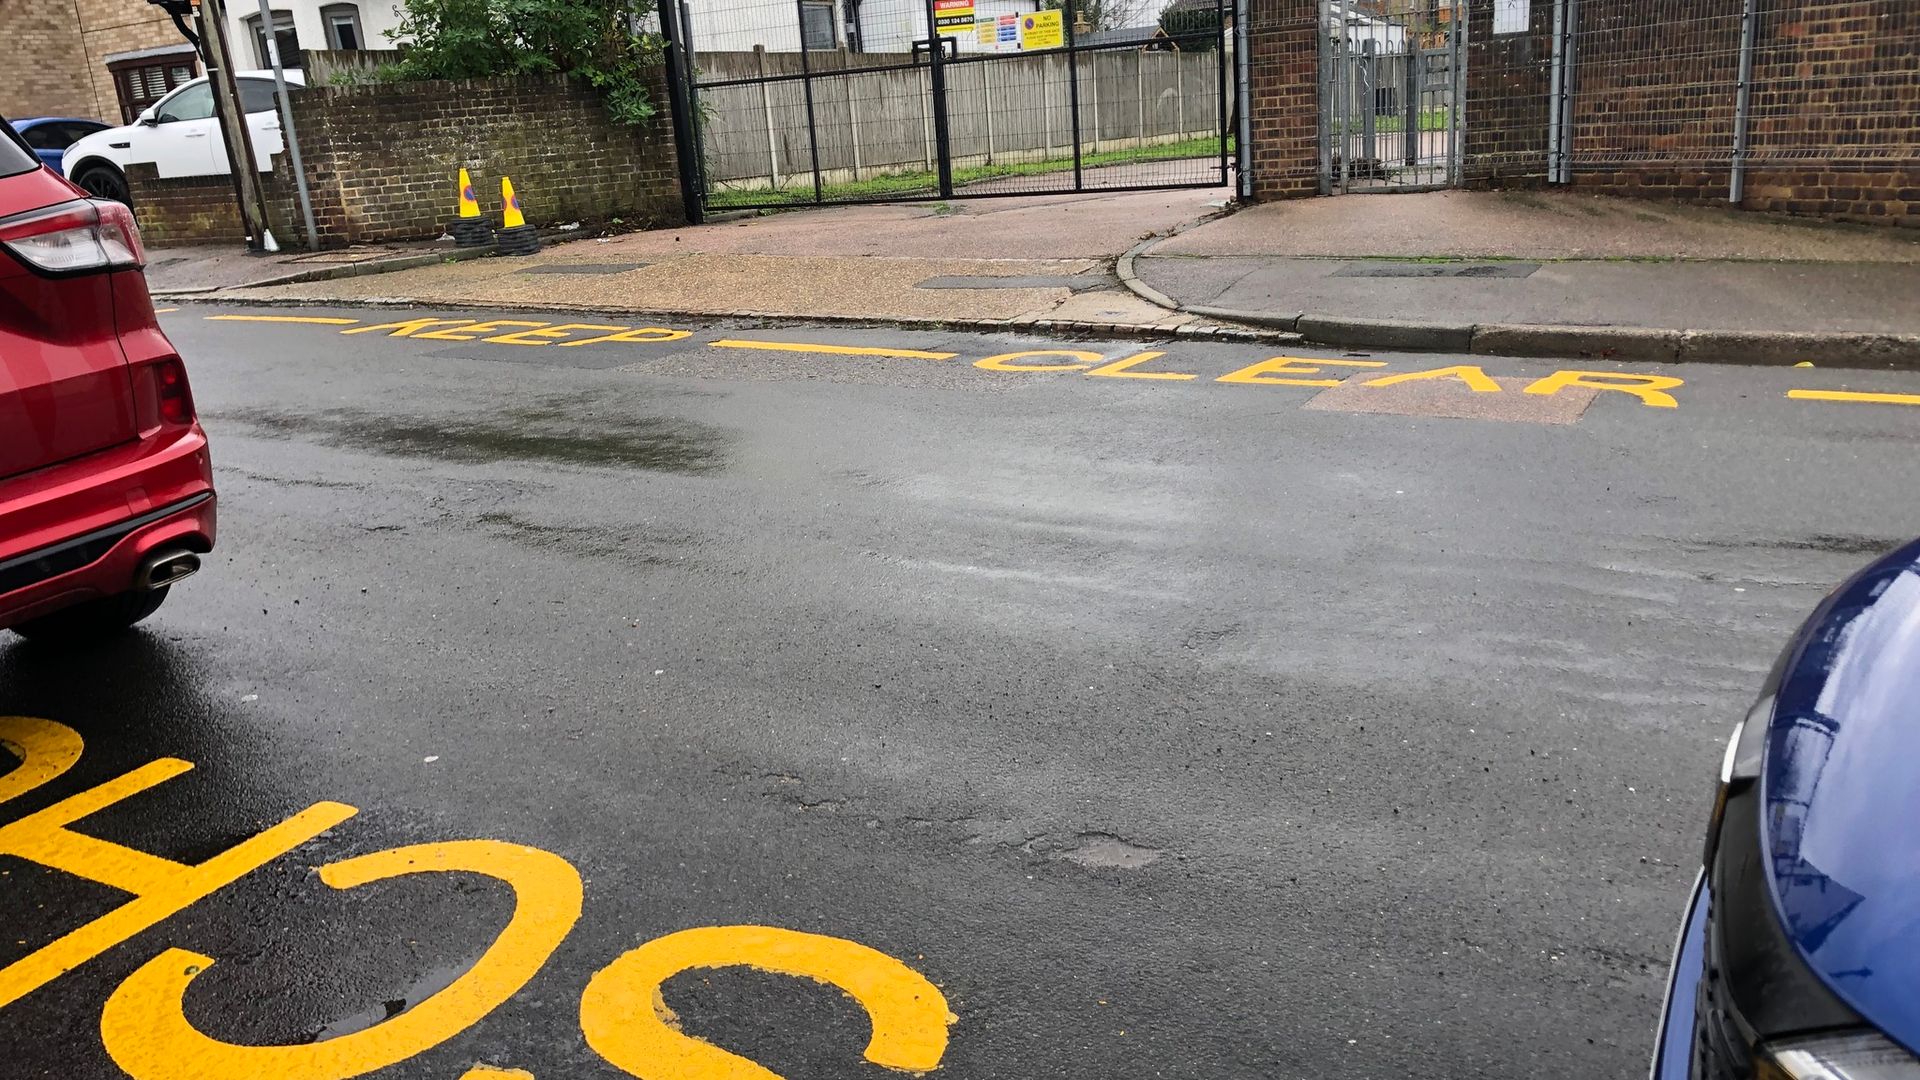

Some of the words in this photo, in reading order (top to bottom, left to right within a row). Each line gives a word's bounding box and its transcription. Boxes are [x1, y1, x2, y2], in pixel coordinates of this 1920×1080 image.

[940, 0, 969, 8] WARNING
[342, 317, 692, 347] KEEP
[974, 349, 1684, 409] CLEAR
